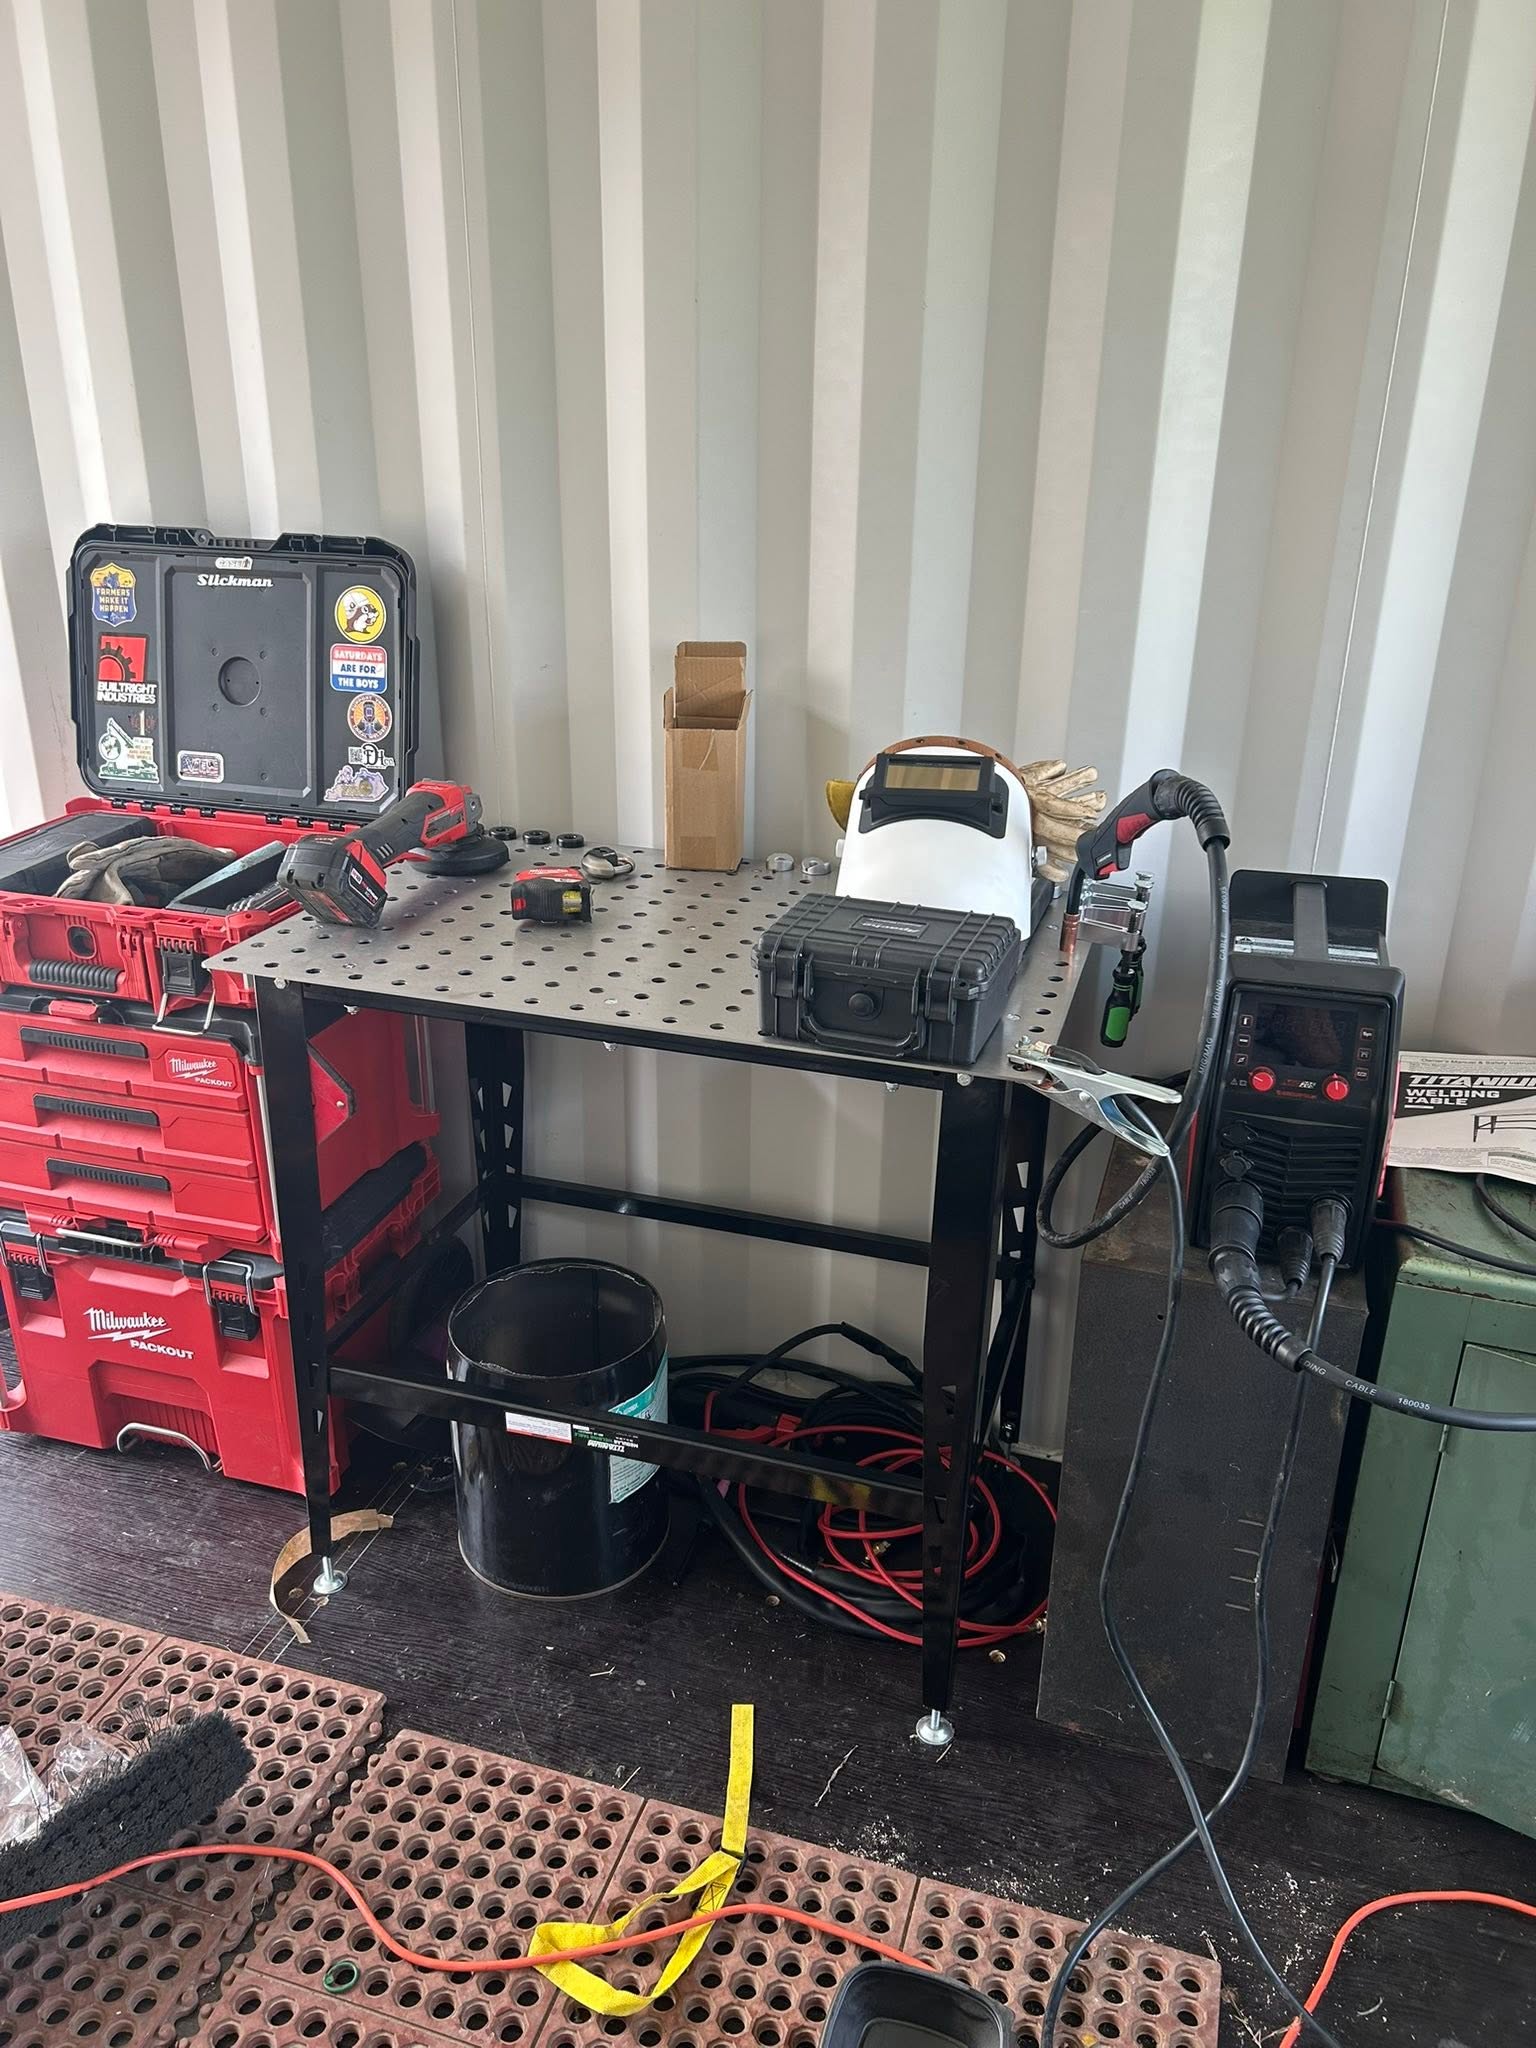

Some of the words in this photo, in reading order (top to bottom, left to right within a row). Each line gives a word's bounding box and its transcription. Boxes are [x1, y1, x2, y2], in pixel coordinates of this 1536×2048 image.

[196, 573, 274, 587] Slickman
[96, 588, 130, 597] FARMERS
[99, 596, 119, 604] MAKE
[100, 604, 128, 612] HAPPEN
[334, 649, 383, 661] SATURDAYS
[341, 664, 356, 672] ARE
[359, 665, 376, 674] FOR
[98, 681, 158, 694] BUILTRIGHT
[338, 677, 354, 687] THE
[356, 678, 379, 689] BOYS
[97, 691, 157, 704] INDUSTRIES
[1198, 1037, 1213, 1075] MIG/MAG
[1211, 979, 1223, 1020] WELDING
[1219, 934, 1227, 961] CABLE
[169, 1057, 218, 1073] Milwaukee
[194, 1077, 233, 1088] PACKOUT
[1406, 1089, 1500, 1099] WELDING
[1405, 1096, 1468, 1106] TABLE
[83, 1307, 167, 1332] Milwaukee
[130, 1339, 194, 1359] PACKOUT
[1344, 1378, 1377, 1397] CABLE
[1398, 1397, 1430, 1411] 180035
[587, 1440, 625, 1453] TITANIUM
